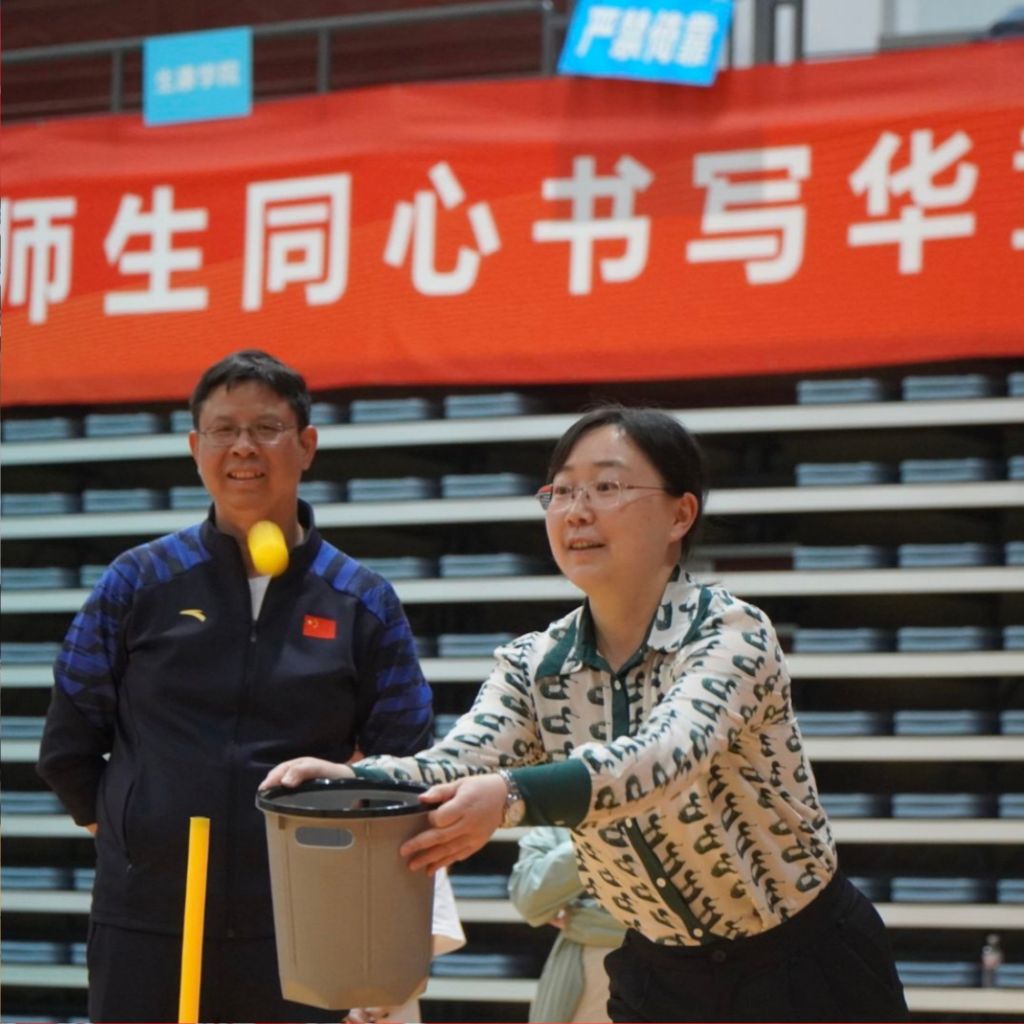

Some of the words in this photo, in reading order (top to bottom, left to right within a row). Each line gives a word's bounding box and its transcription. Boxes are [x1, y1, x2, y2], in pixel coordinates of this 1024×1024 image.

[0, 127, 1024, 325] 师生同心书写华
